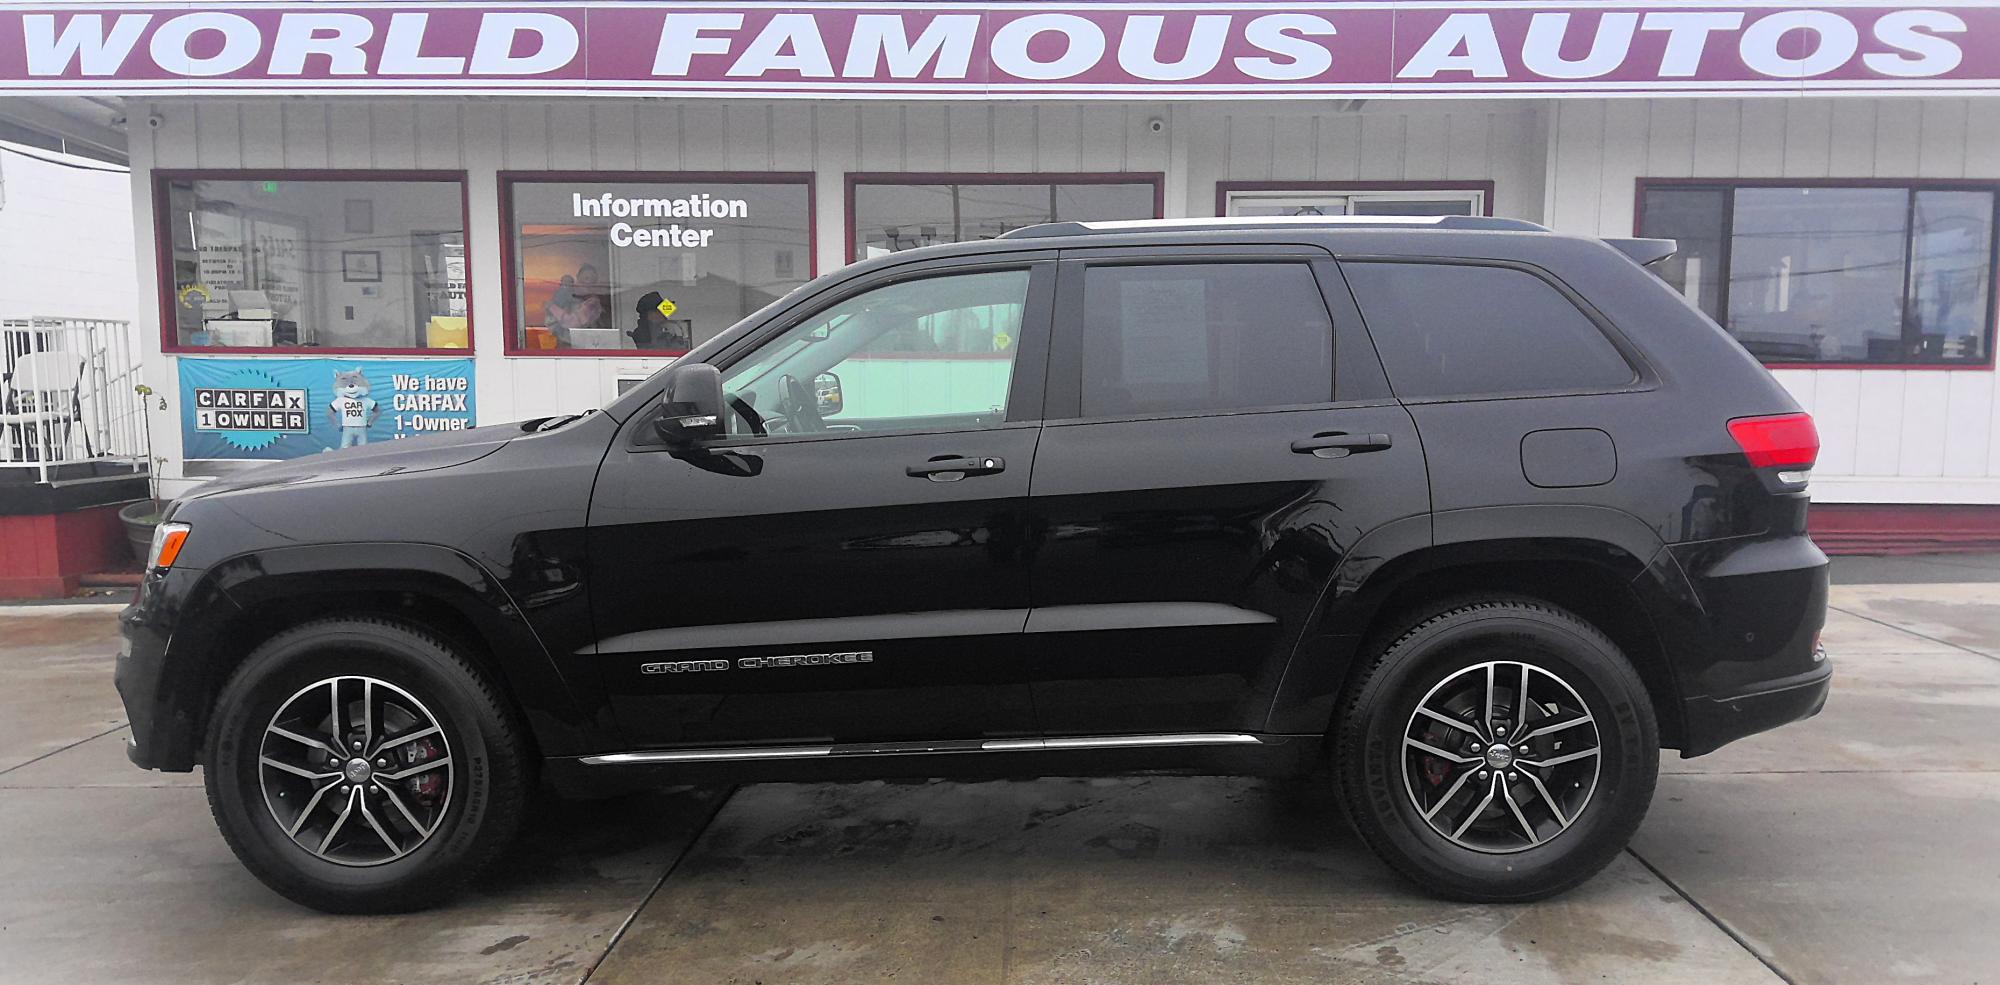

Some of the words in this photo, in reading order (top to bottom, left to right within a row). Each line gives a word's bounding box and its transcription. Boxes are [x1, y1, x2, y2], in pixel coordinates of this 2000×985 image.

[22, 12, 579, 77] WORLD
[651, 13, 1337, 81] FAMOUS
[1395, 9, 1968, 79] AUTOS
[573, 193, 748, 218] Information
[610, 222, 714, 247] Center
[392, 374, 420, 391] We
[425, 374, 468, 391] have
[199, 391, 301, 409] CARFAX
[344, 401, 363, 410] CAR
[393, 393, 467, 411] CARFAX
[346, 409, 363, 418] FOX
[394, 414, 469, 431] 1-Owner
[641, 659, 730, 674] GRAND
[738, 651, 874, 668] CHEROKEE
